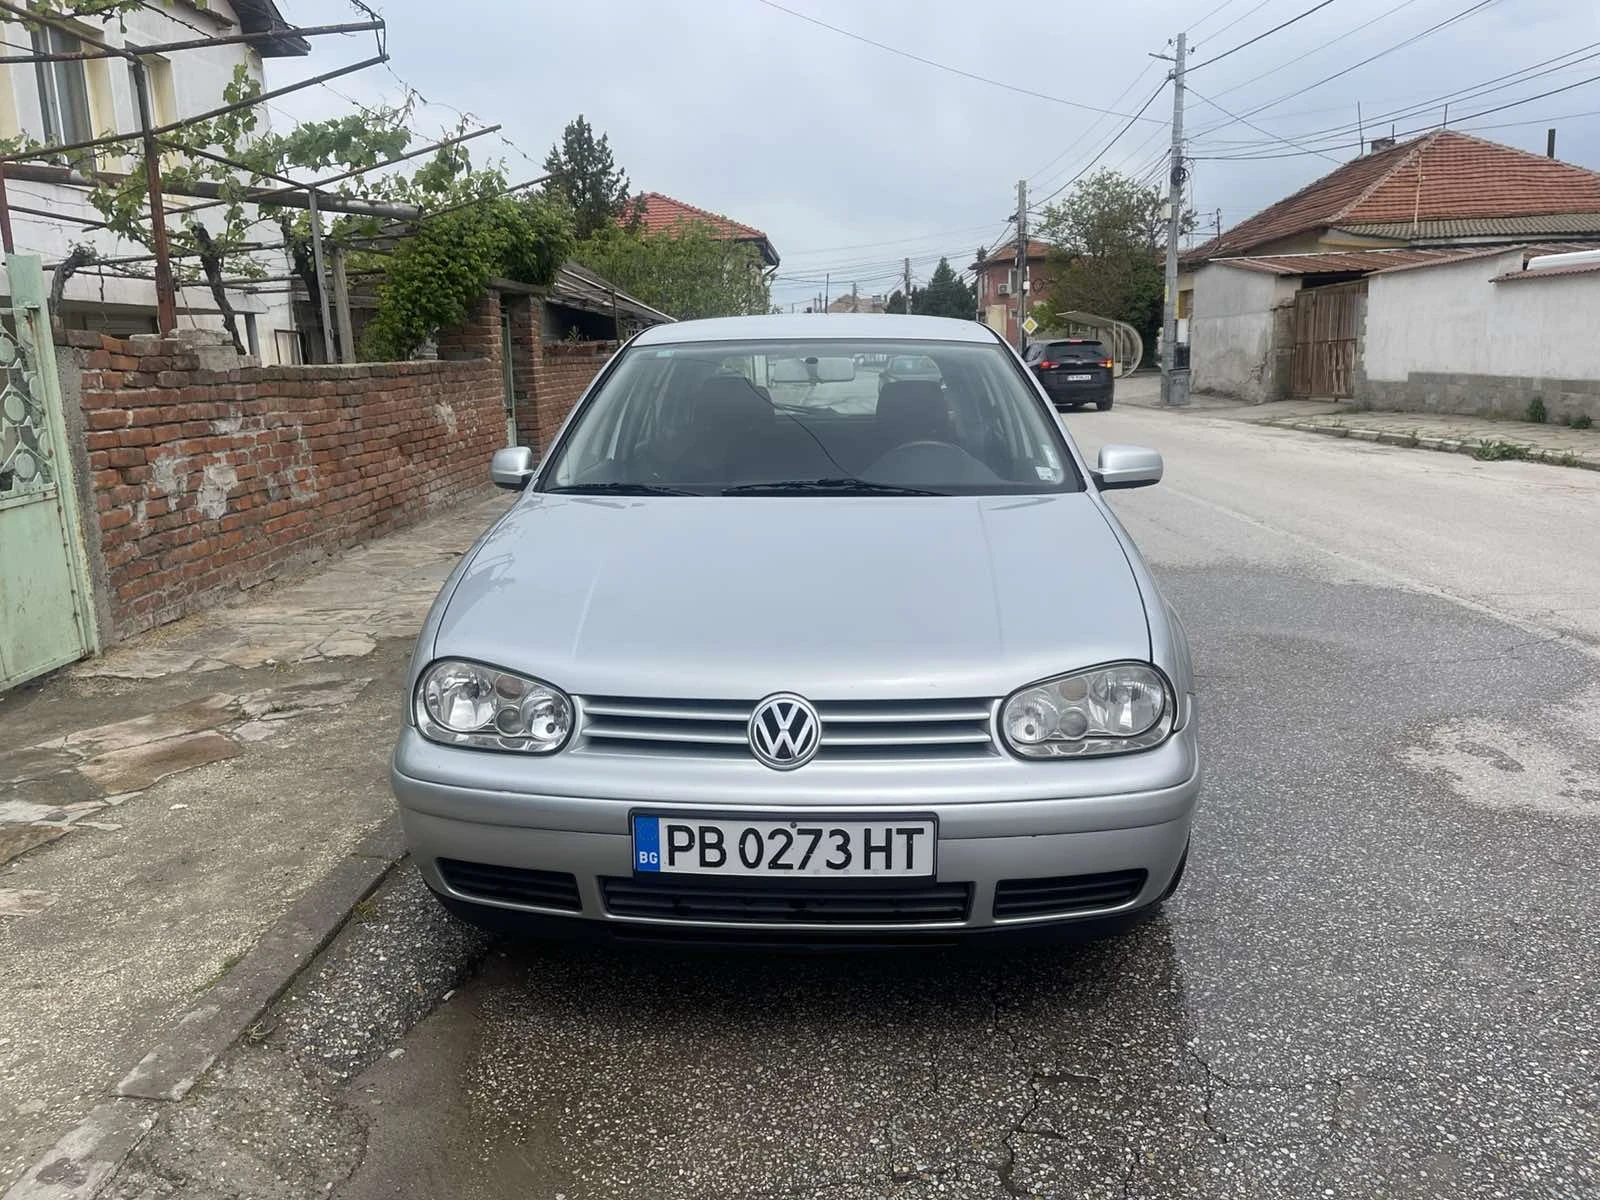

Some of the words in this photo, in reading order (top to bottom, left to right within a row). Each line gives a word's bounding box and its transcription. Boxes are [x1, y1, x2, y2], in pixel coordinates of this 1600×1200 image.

[754, 700, 815, 761] VW
[639, 851, 658, 864] BG
[667, 824, 728, 869] PB
[738, 827, 853, 871] 0273
[863, 827, 925, 871] HT
